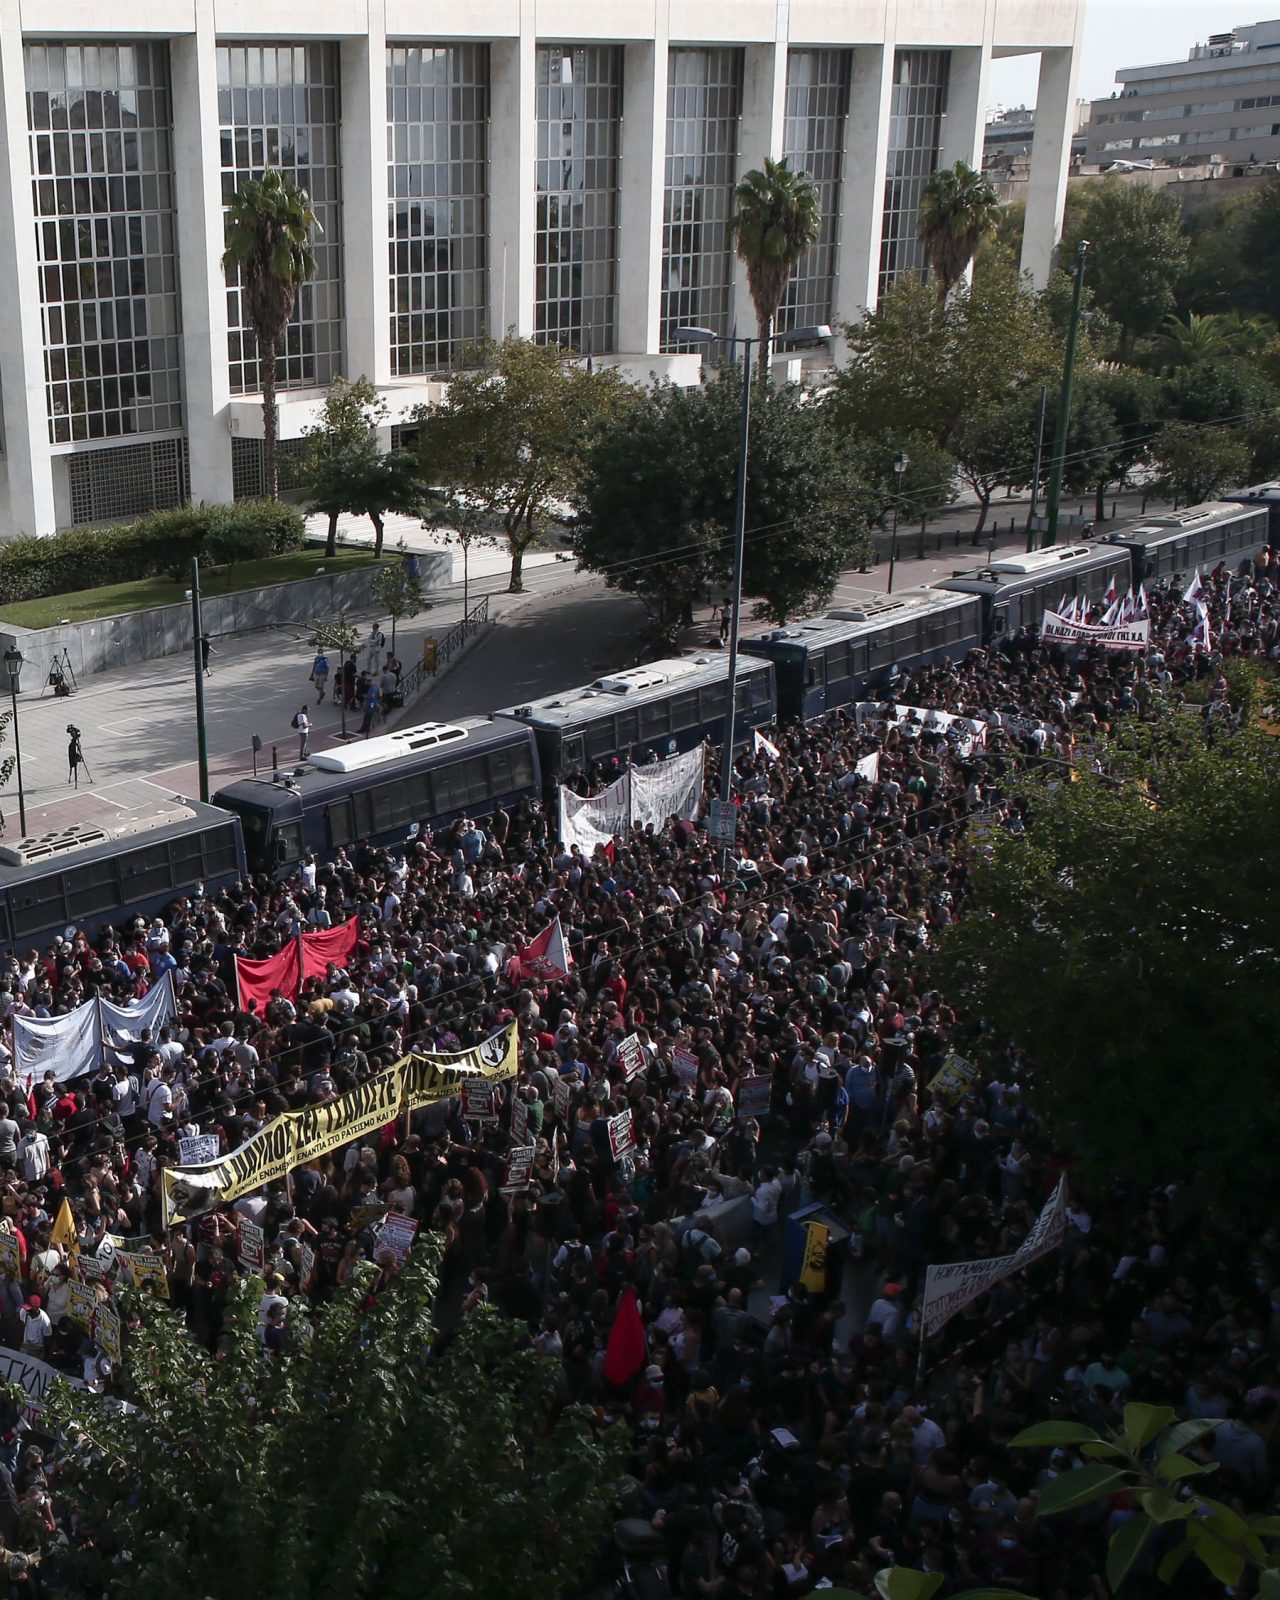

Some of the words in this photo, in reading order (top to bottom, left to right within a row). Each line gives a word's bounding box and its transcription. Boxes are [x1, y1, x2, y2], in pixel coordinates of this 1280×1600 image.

[229, 1119, 293, 1185] ΠΑΥΛΟΣ
[322, 1069, 397, 1134] ΤΣΑΚΙΣΤΕ
[259, 1156, 295, 1180] ΕΝΩΜΕΝΟΙ
[297, 1141, 326, 1161] ΕΝΑΝΤΙΑ
[328, 1134, 341, 1148] ΣΤΟ
[341, 1116, 375, 1140] ΡΑΤΣΙΣΜΟ
[376, 1112, 389, 1126] ΚΑΙ
